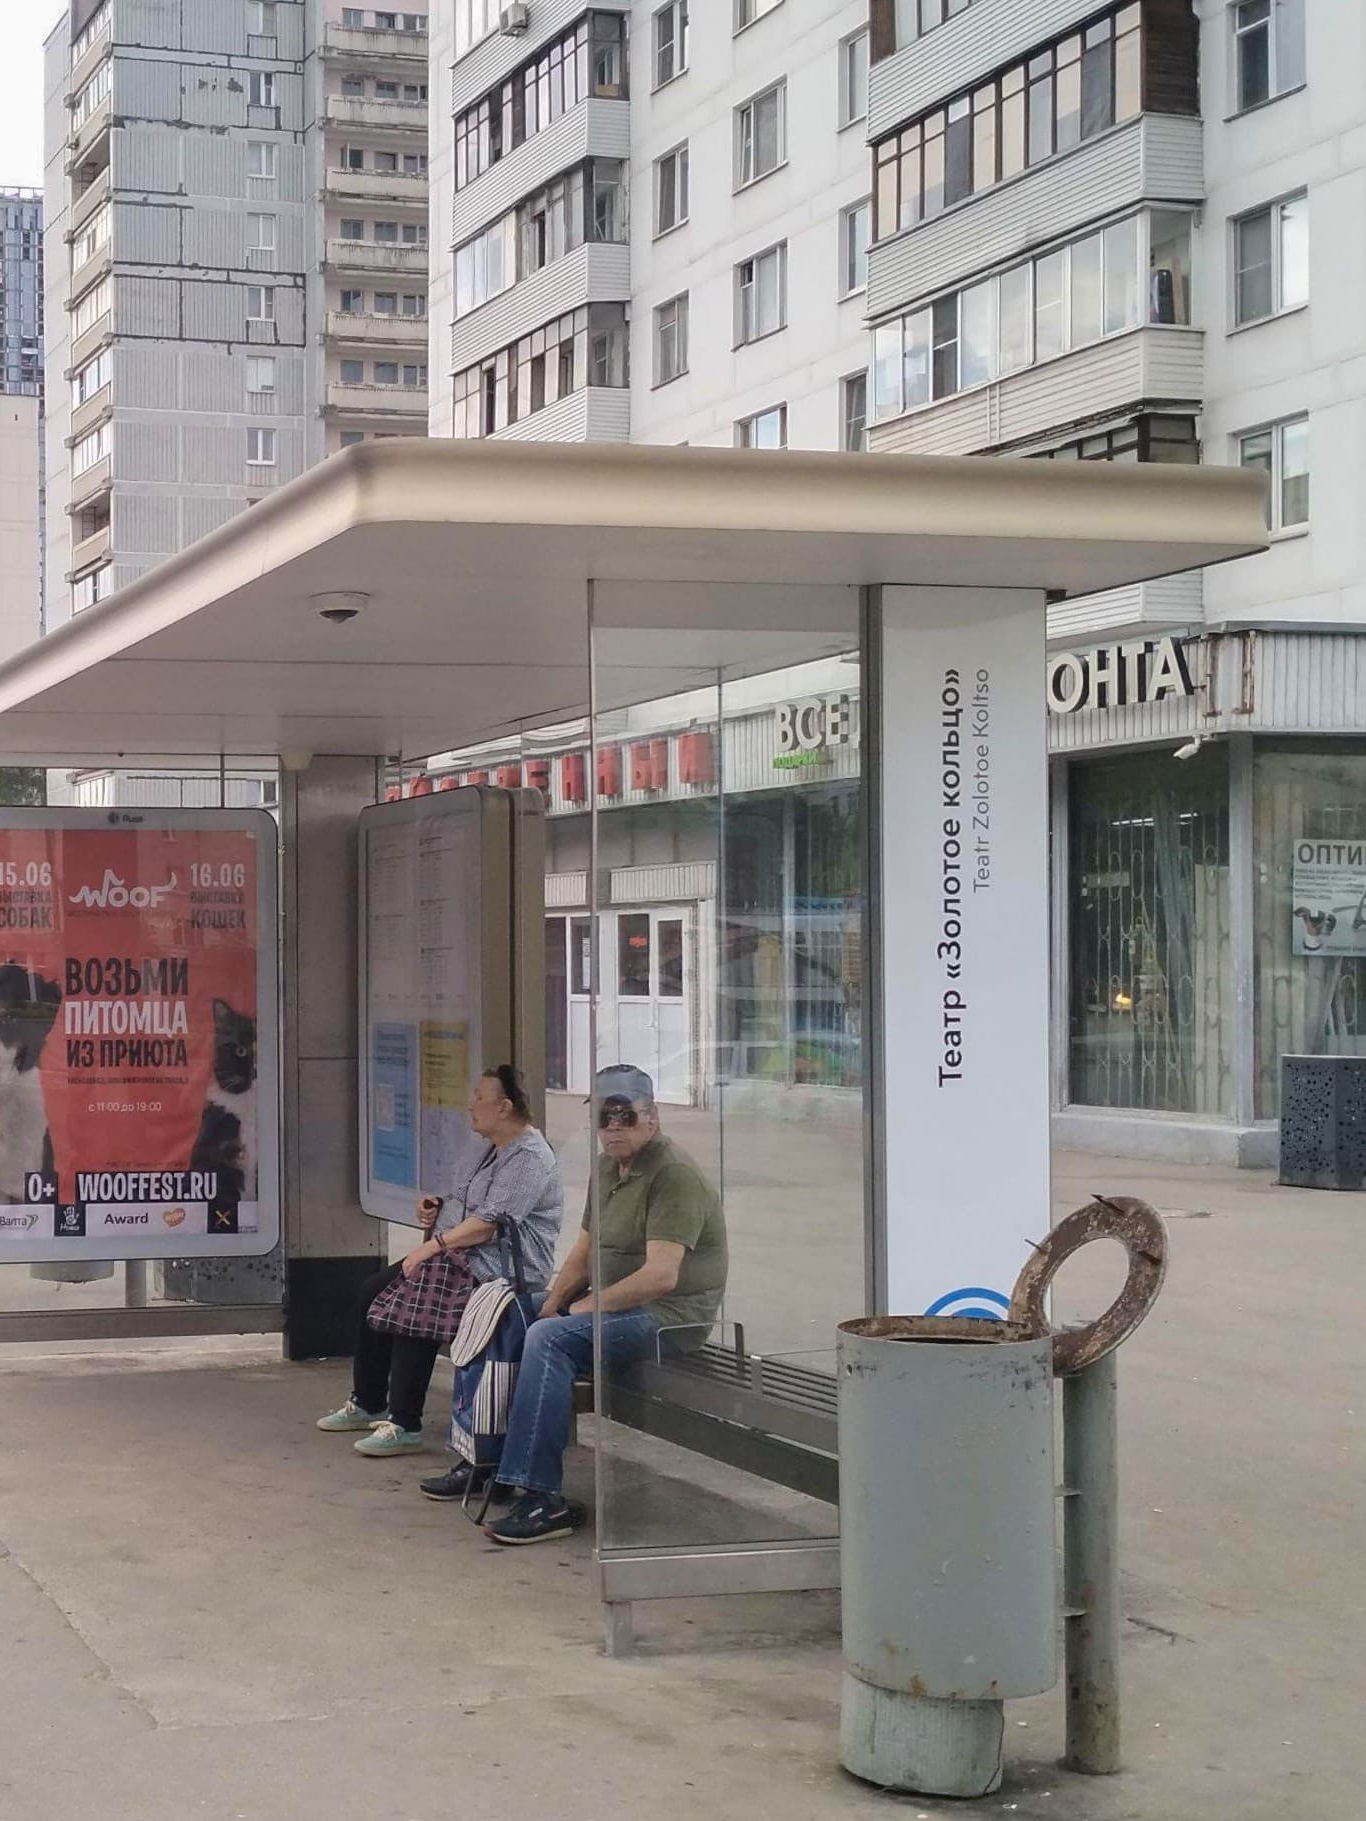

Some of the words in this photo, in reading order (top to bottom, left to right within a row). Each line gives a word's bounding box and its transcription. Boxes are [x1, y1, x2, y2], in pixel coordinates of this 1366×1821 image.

[775, 694, 848, 752] ВСЕ
[1045, 636, 1194, 714] ОНТА
[972, 668, 990, 738] Koltso
[941, 667, 963, 808] кольцо»
[972, 744, 990, 830] Zolotoe
[973, 835, 990, 894] Teatr
[1297, 843, 1366, 866] ОПТИ
[69, 868, 178, 908] WOOF
[189, 863, 245, 888] 16.06
[190, 908, 247, 929] КОШЕК
[937, 818, 961, 980] «Золотое
[64, 957, 189, 996] ВОЗЬМИ
[64, 1001, 189, 1038] ПИТОМЦА
[938, 989, 967, 1088] Театр
[67, 1040, 94, 1068] ИЗ
[100, 1039, 188, 1068] ПРИЮТА
[28, 1172, 55, 1201] 0+
[78, 1171, 218, 1200] WOOFFEST.RU
[104, 1213, 149, 1225] Award
